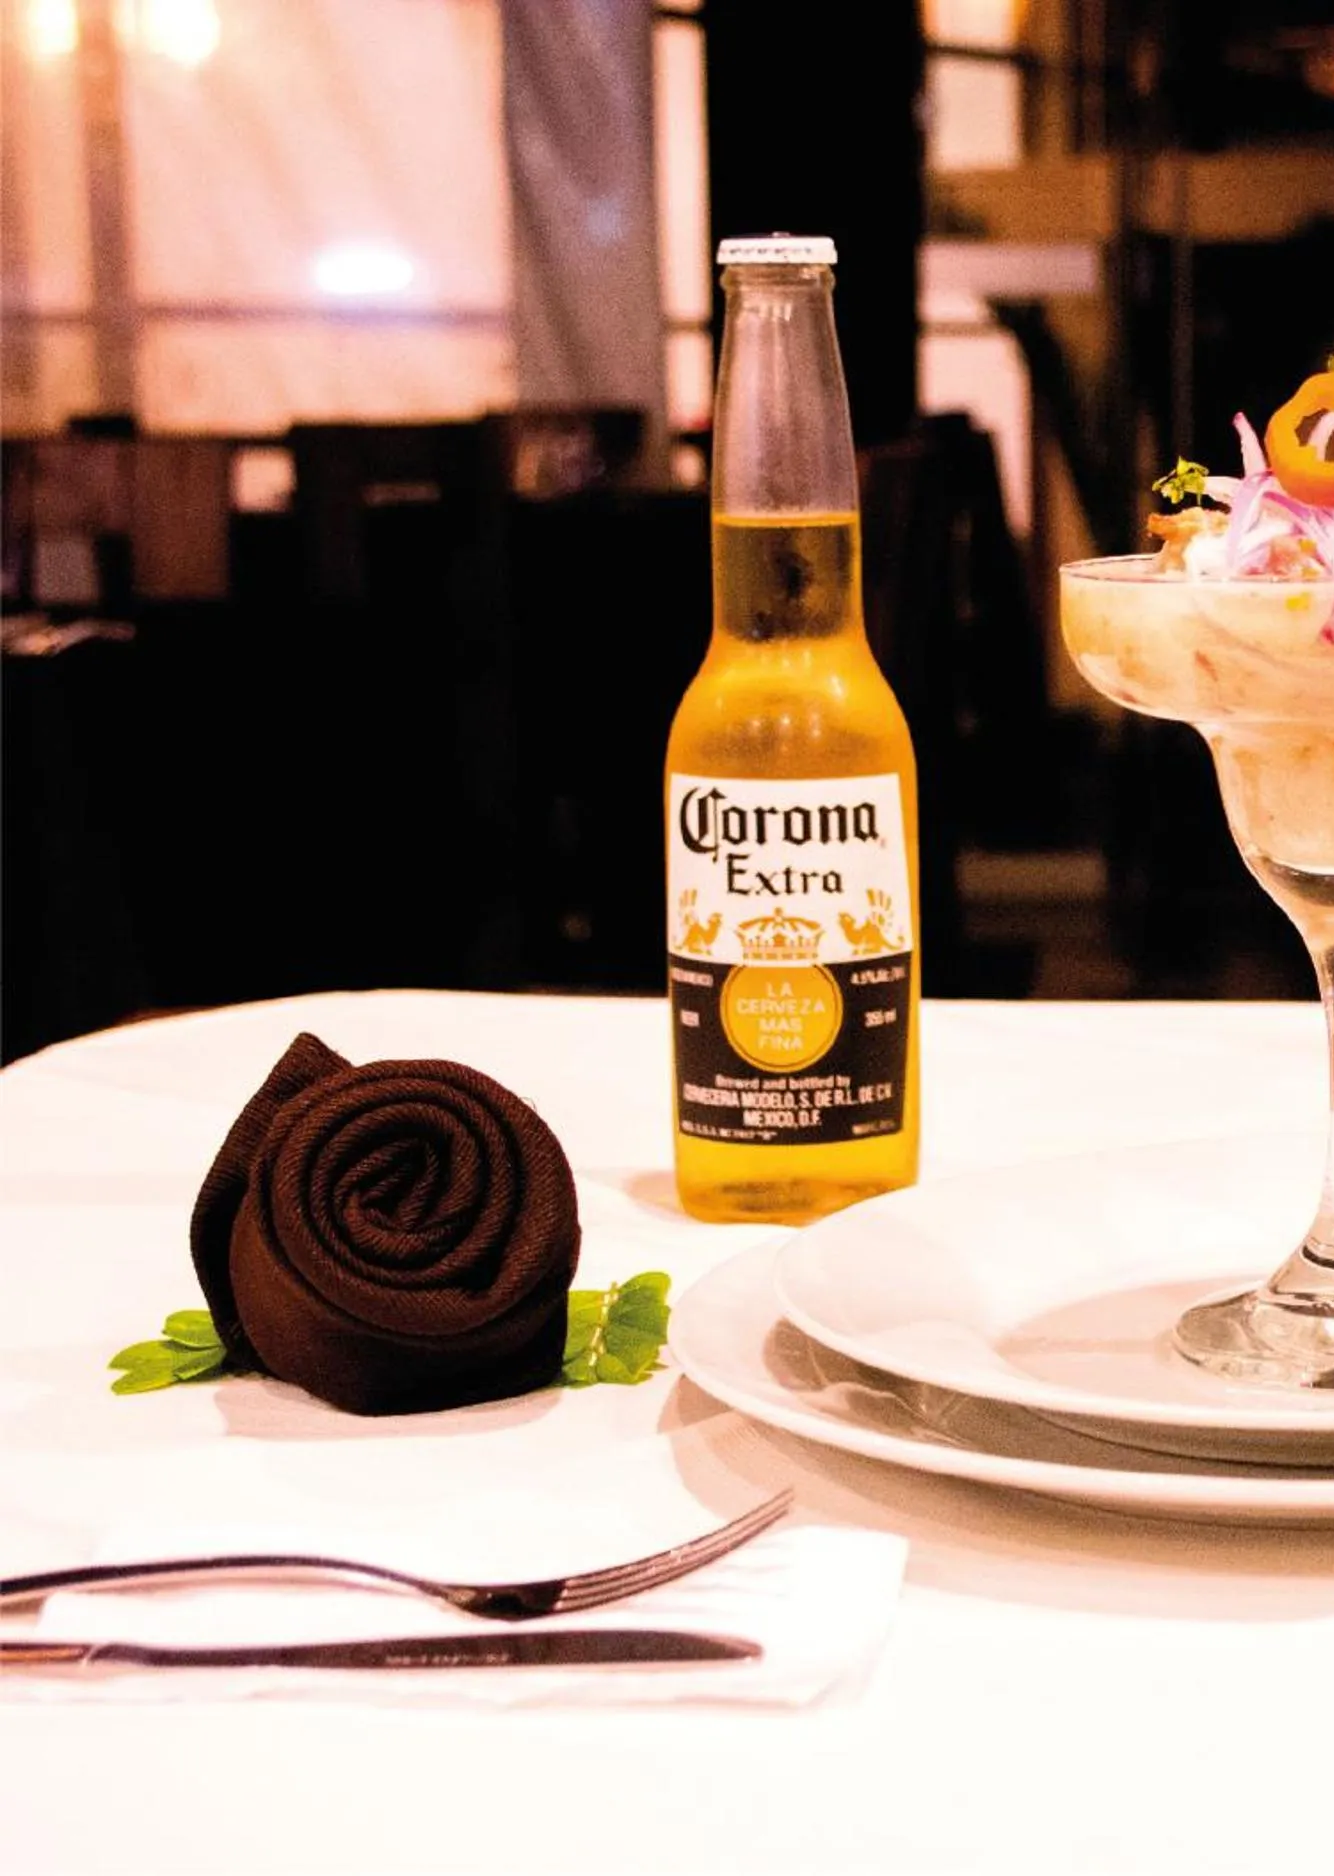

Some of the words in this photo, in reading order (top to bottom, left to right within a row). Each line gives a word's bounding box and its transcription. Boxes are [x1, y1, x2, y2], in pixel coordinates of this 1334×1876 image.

[680, 787, 880, 863] Corona
[725, 853, 844, 896] Extra
[765, 982, 794, 998] LA
[736, 998, 827, 1015] CERVEZA
[758, 1017, 803, 1033] MAS
[758, 1034, 804, 1051] FINA
[715, 1074, 760, 1090] Brewed
[763, 1078, 786, 1090] and
[789, 1075, 835, 1090] bottled
[836, 1074, 851, 1091] by
[814, 1089, 833, 1107] DE
